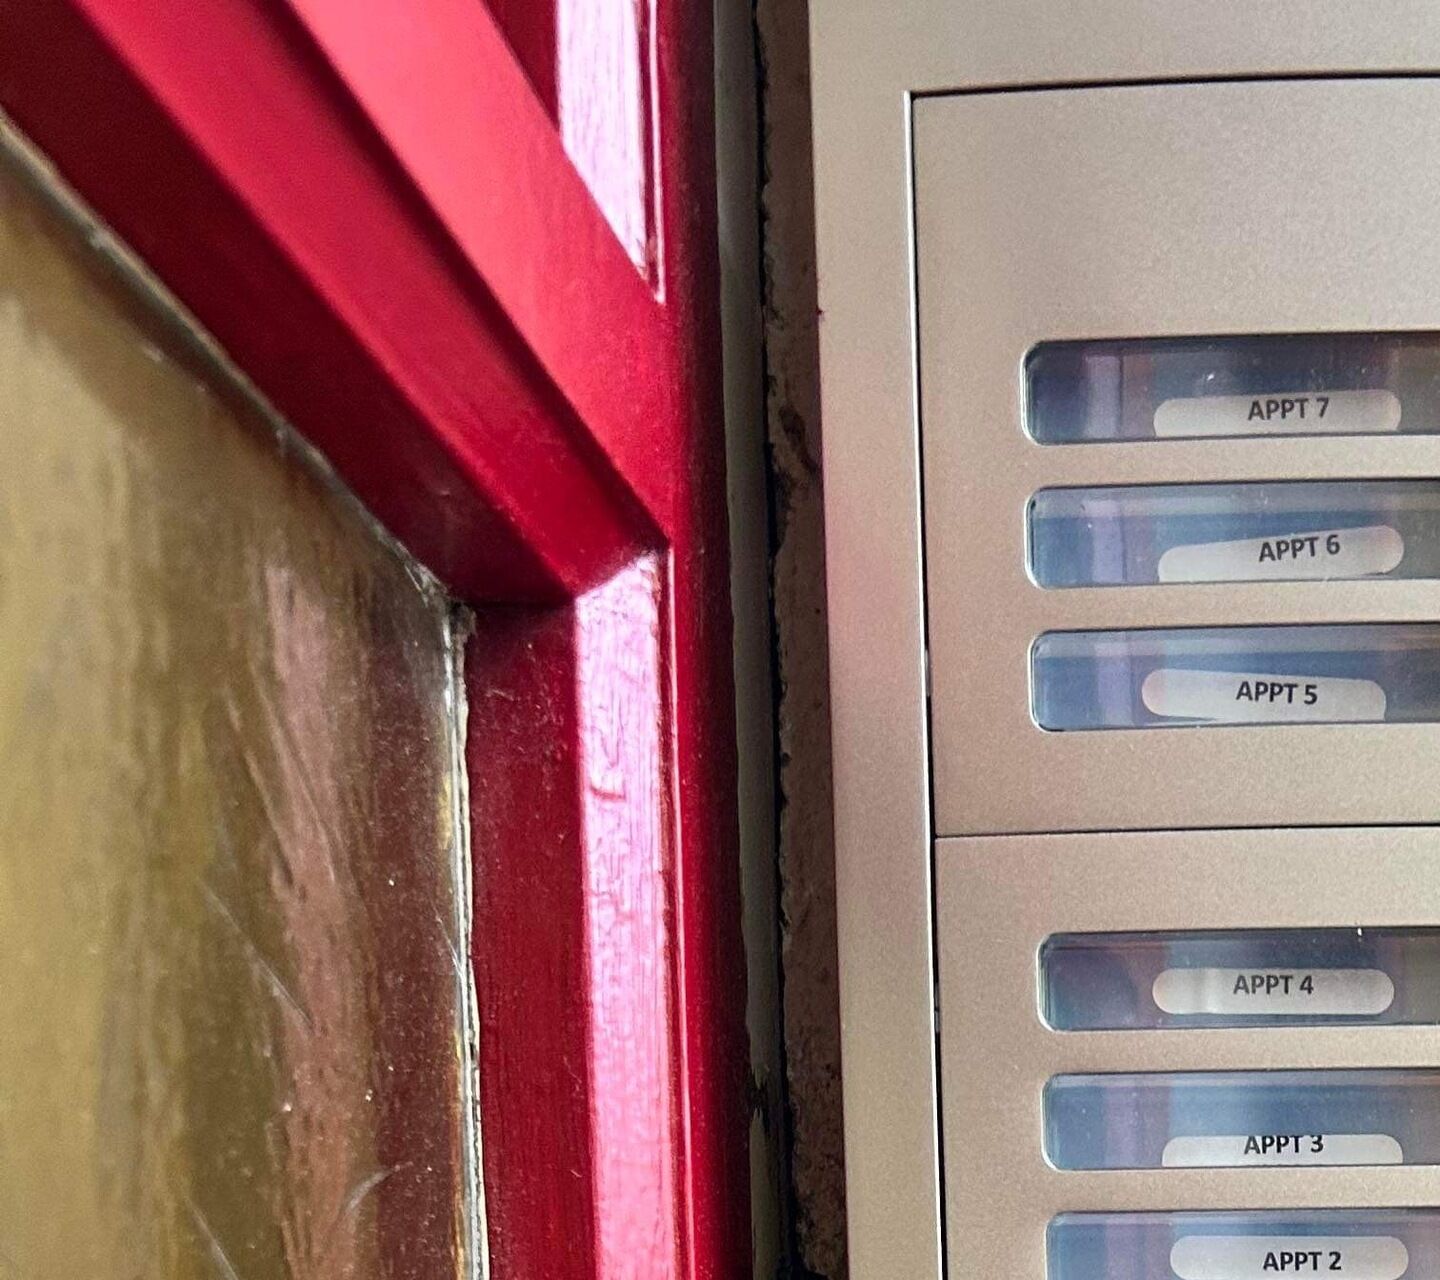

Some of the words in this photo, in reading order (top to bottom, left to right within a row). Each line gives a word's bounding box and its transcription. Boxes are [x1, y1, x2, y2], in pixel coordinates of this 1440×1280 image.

[1247, 397, 1310, 421] APPT
[1315, 396, 1331, 418] 7
[1258, 537, 1320, 563] APPT
[1325, 534, 1341, 556] 6
[1235, 680, 1300, 704] APPT
[1303, 683, 1318, 706] 5
[1233, 974, 1295, 995] APPT
[1299, 974, 1315, 995] 4
[1243, 1135, 1304, 1155] APPT
[1309, 1134, 1324, 1153] 3
[1262, 1251, 1323, 1272] APPT
[1328, 1250, 1342, 1271] 2
